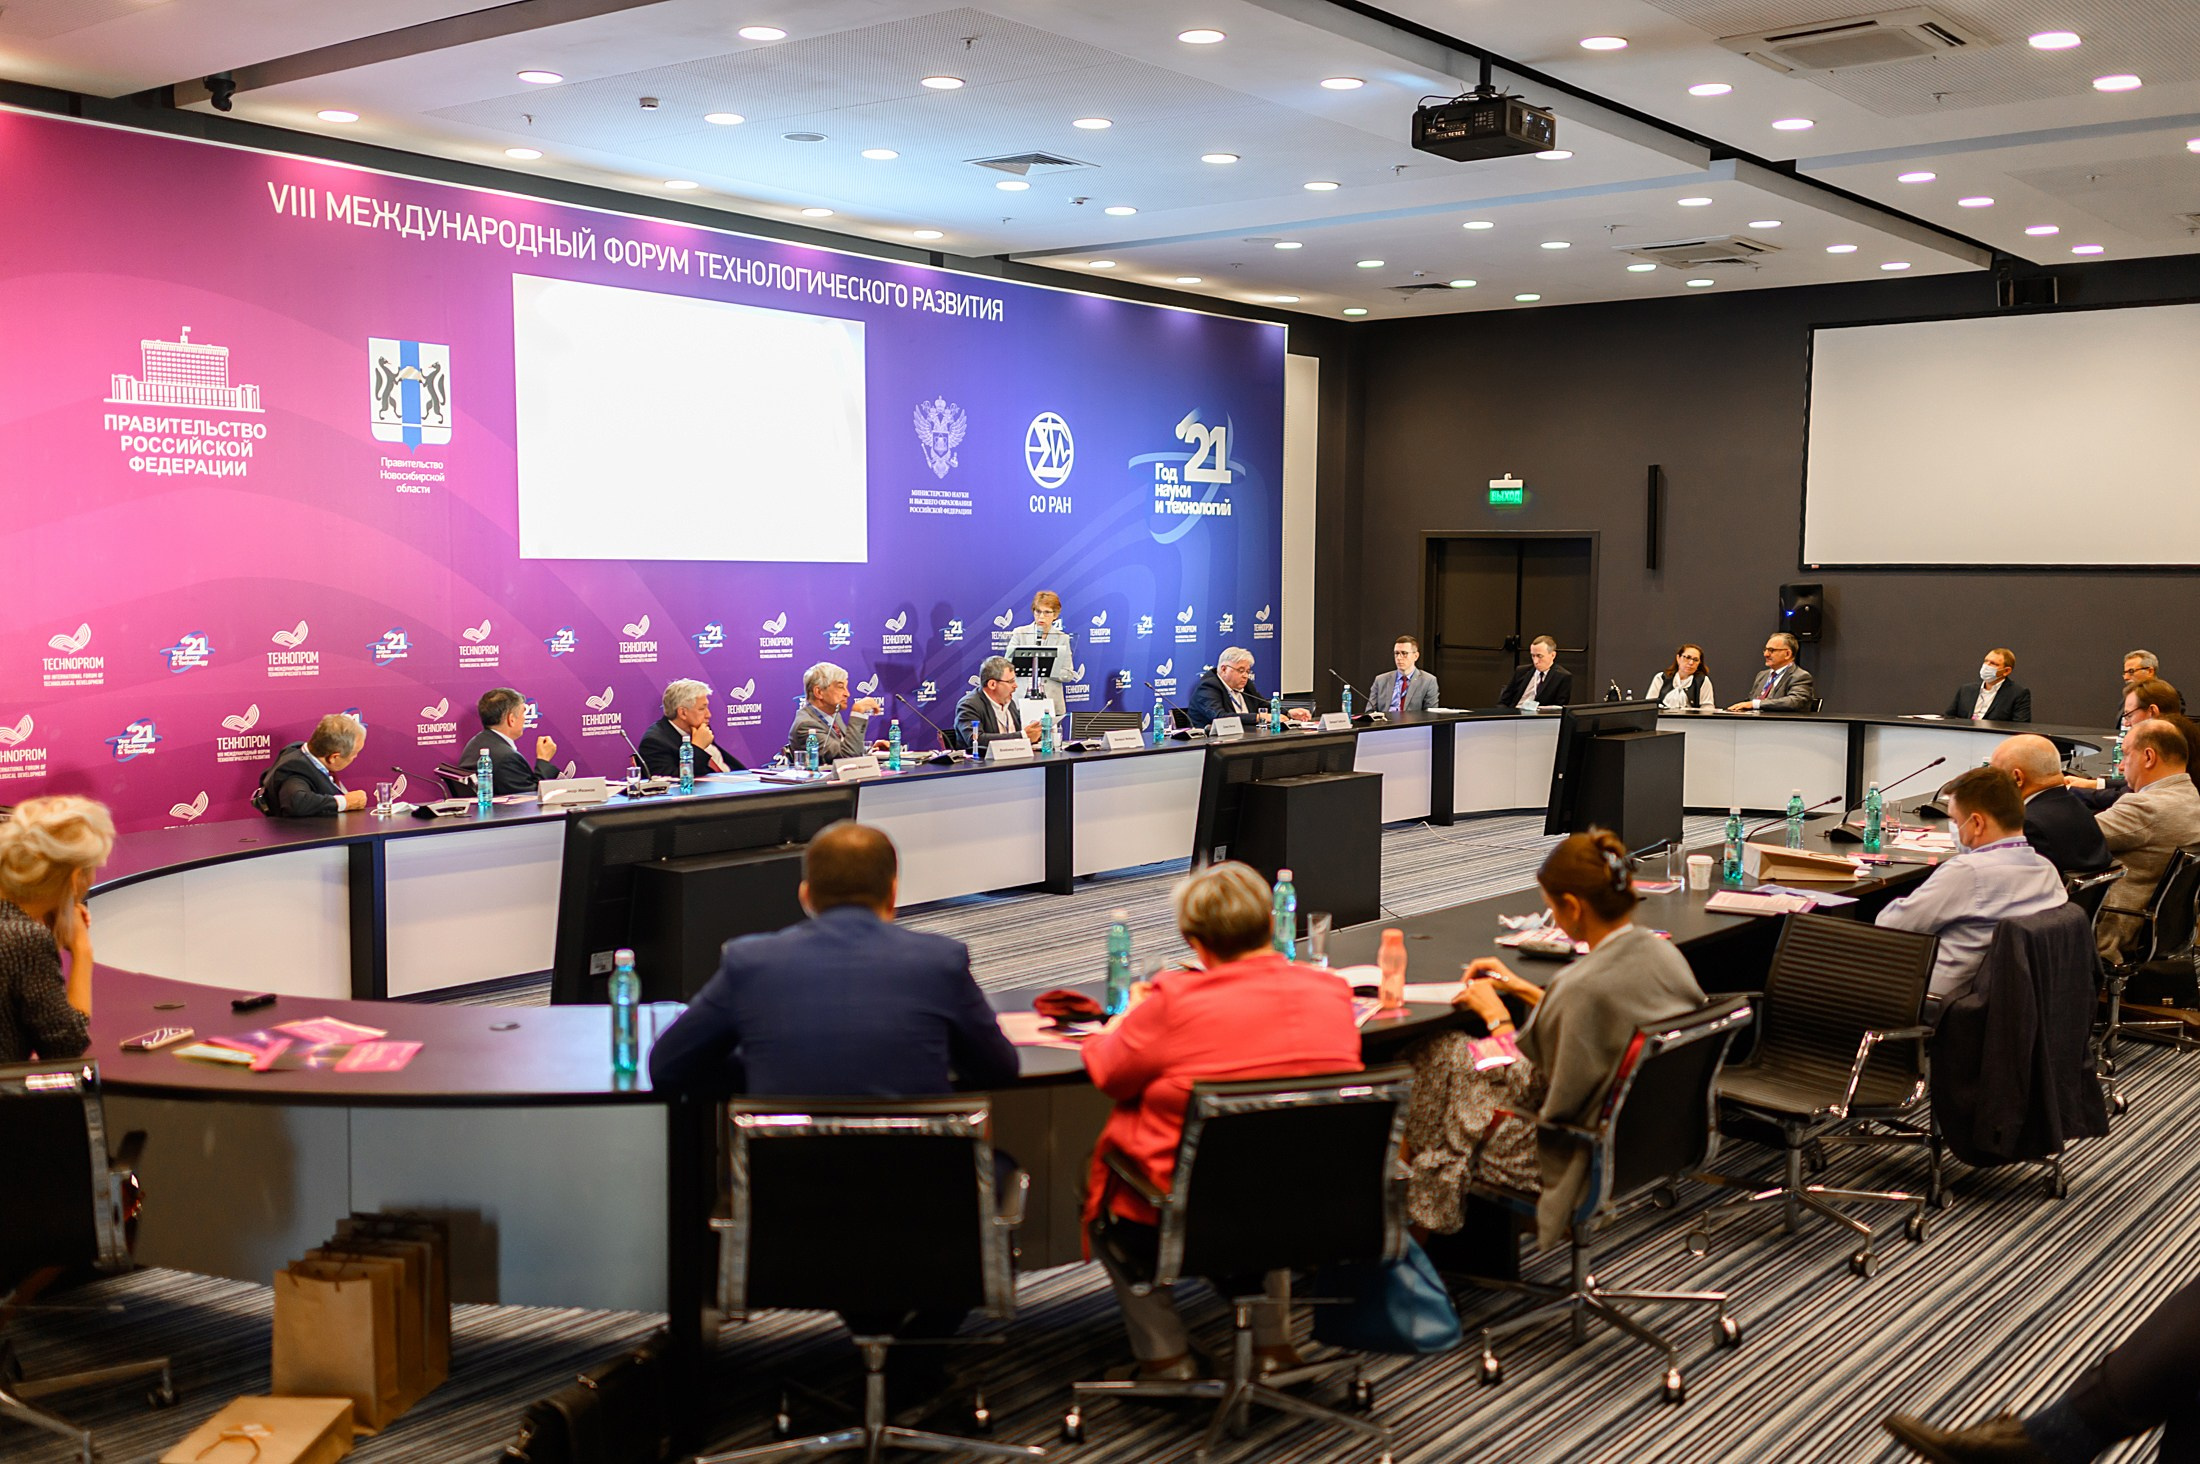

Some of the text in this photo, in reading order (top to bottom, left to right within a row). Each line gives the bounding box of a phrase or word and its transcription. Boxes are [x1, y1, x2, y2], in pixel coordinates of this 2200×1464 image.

[268, 182, 1004, 322] VIII МЕЖДУНАРОДНЫЙ ФОРУМ ТЕХНОЛОГИЧЕСКОГО РАЗВИТИЯ
[104, 414, 267, 439] ПРАВИТЕЛЬСТВО
[120, 433, 254, 458] РОССИЙСКОЙ
[129, 456, 247, 477] ФЕДЕРАЦИИ
[380, 457, 444, 470] Правительство
[380, 470, 445, 483] Новосибирской
[1154, 462, 1179, 484] Год
[396, 483, 431, 494] области
[1154, 483, 1192, 501] науки
[1491, 490, 1520, 502] ВЫХОД
[1029, 495, 1072, 514] СО РАН
[1154, 498, 1232, 516] и технологий
[759, 637, 793, 647] TECHNOPROM
[459, 645, 499, 656] TECHNOPROM
[42, 656, 105, 671] TECHNOPROM
[727, 703, 762, 714] TECHNOPROM
[417, 722, 457, 734] TECHNOPROM
[216, 735, 270, 750] ТЕХНОПРОМ
[0, 748, 46, 763] HNOPROM
